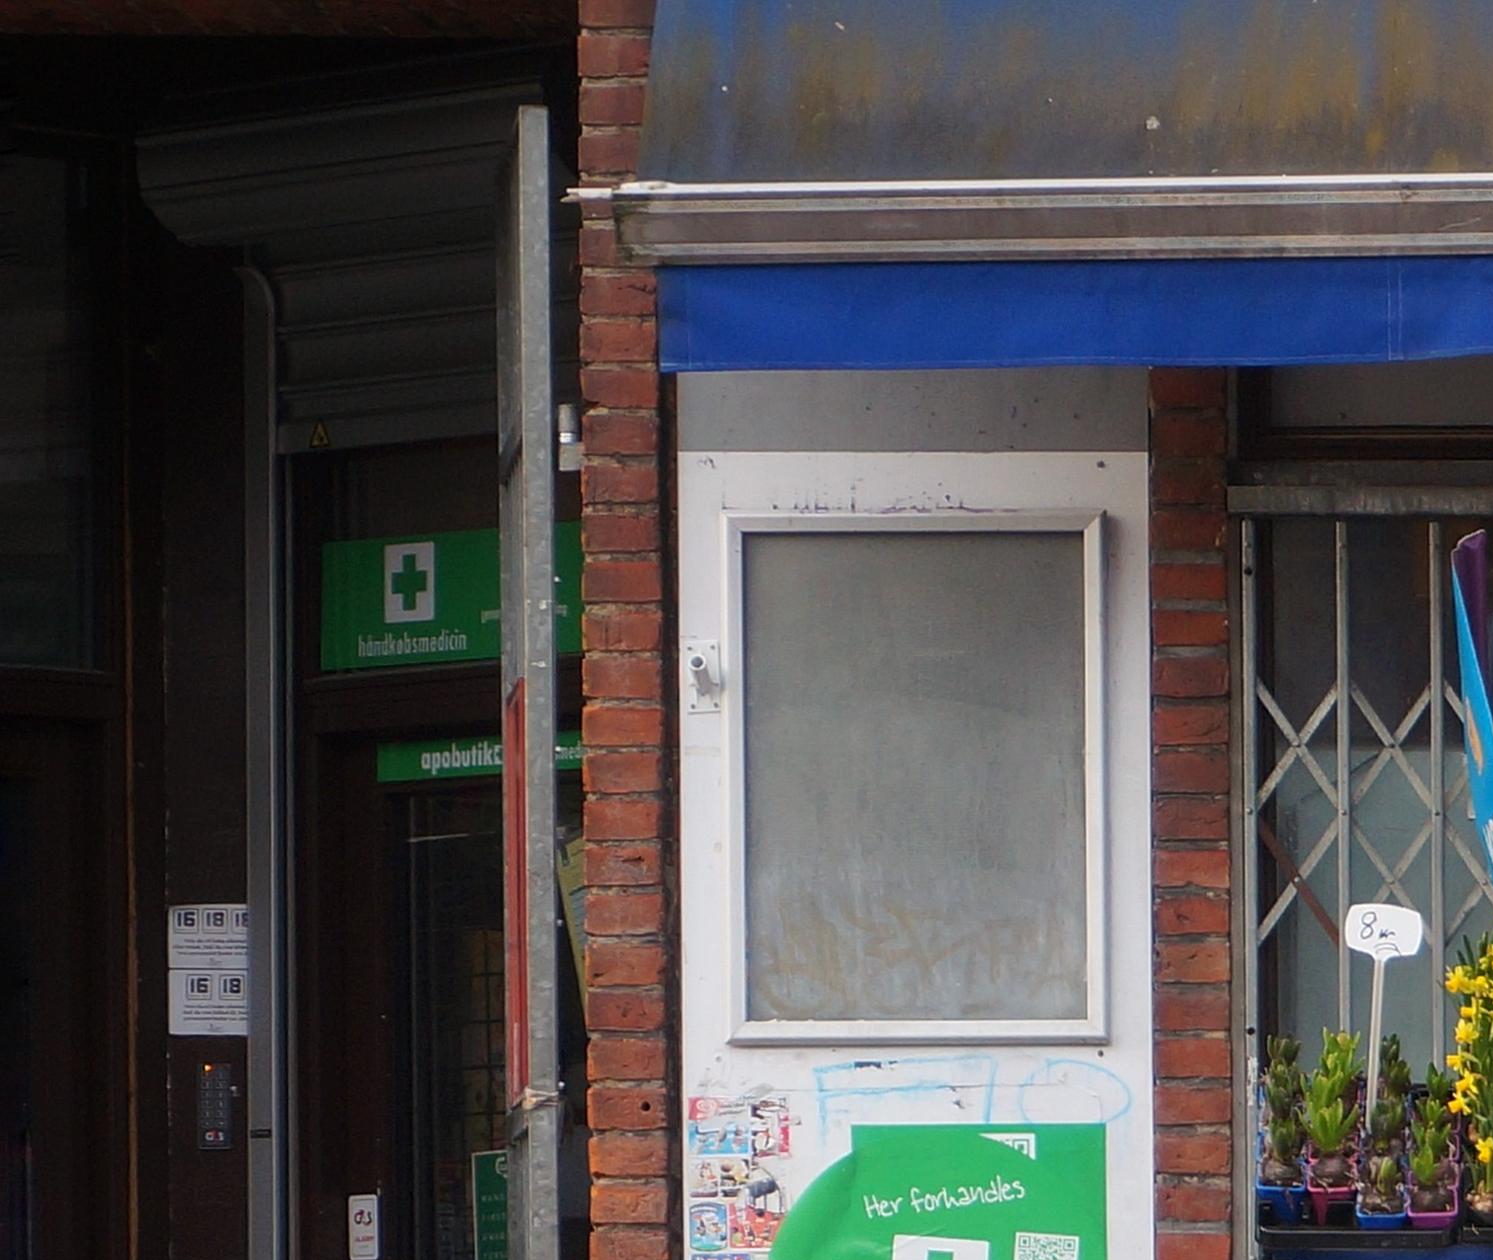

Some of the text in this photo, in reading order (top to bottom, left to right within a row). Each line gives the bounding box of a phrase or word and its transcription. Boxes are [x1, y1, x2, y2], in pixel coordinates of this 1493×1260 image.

[421, 744, 494, 775] apobutik
[177, 911, 196, 928] 16
[206, 911, 224, 928] 18
[1360, 911, 1377, 940] 8
[190, 977, 242, 994] 16 18
[864, 1174, 1026, 1219] Her forhandles
